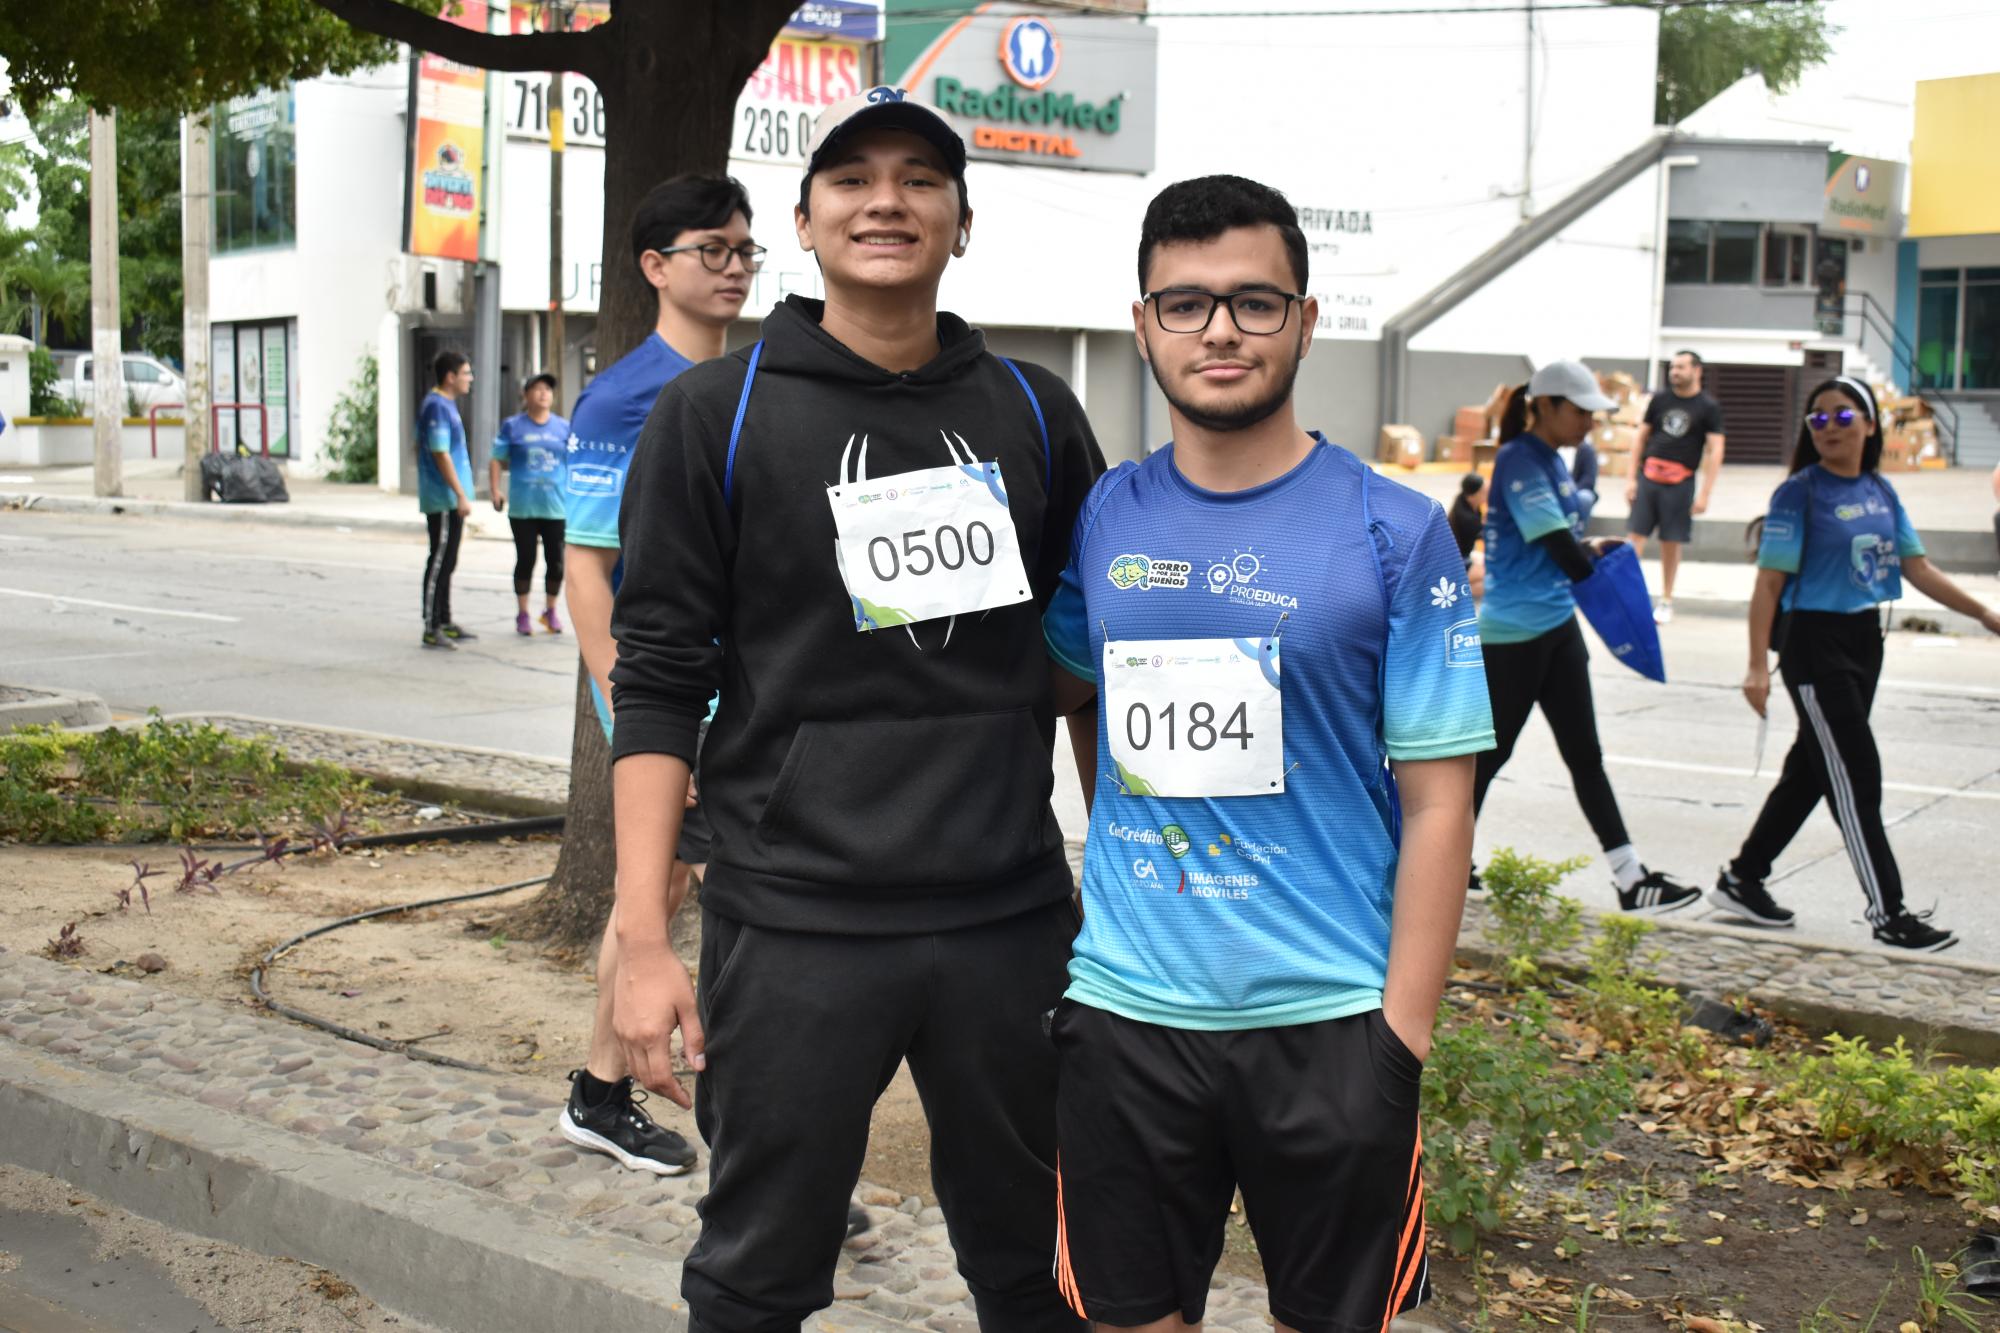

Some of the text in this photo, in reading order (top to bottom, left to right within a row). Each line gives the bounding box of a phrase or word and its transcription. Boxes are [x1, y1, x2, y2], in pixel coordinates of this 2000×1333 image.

[935, 76, 1122, 134] RadioMed
[744, 106, 789, 156] 236
[974, 127, 1083, 158] DIGITAL
[867, 520, 995, 582] 0500
[1151, 562, 1189, 573] CORRO
[1230, 585, 1298, 609] PROEDUCA
[1126, 701, 1254, 751] 0184
